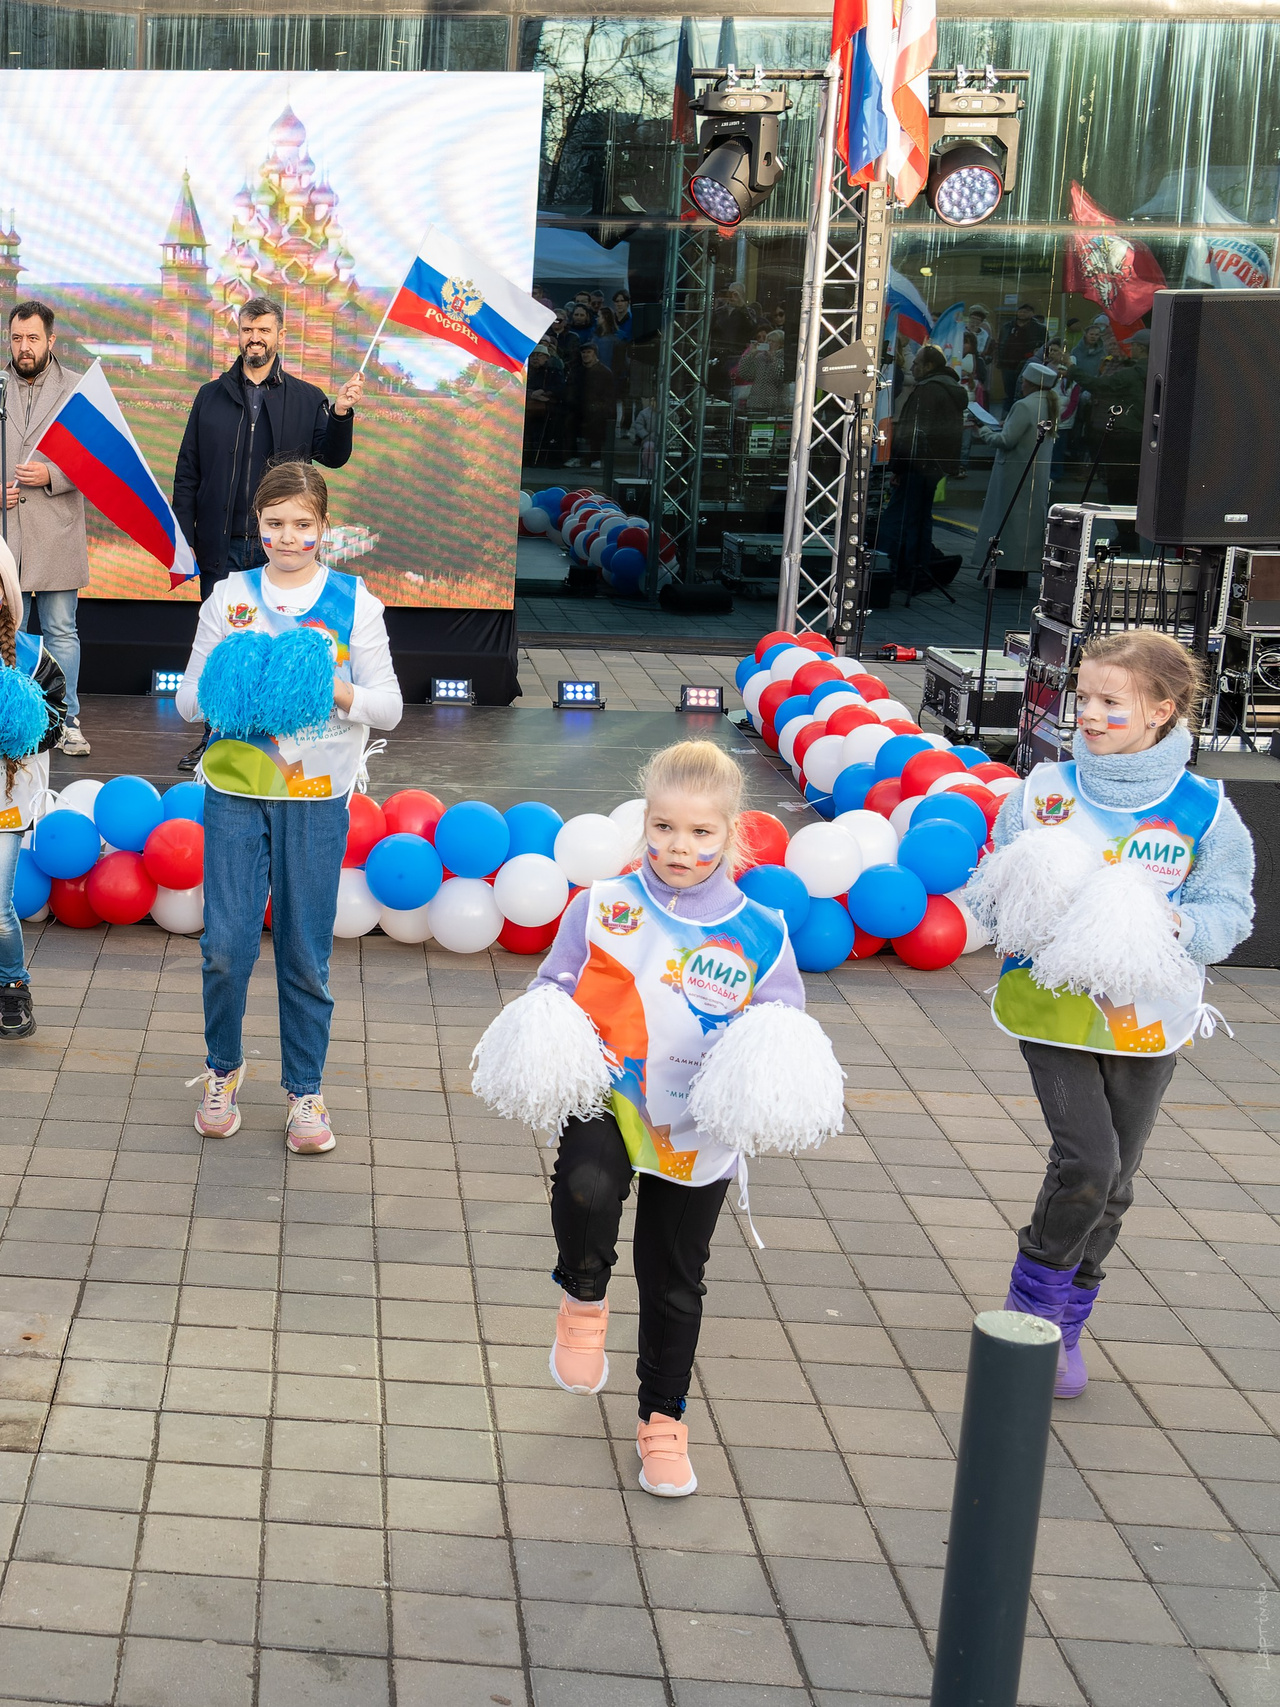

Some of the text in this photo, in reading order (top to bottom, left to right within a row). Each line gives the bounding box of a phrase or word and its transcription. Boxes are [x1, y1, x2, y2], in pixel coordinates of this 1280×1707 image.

[424, 307, 478, 345] РОССИЯ
[1128, 840, 1186, 864] МИР
[1144, 864, 1182, 876] ЛОДЫХ
[690, 954, 747, 988] МИР
[687, 976, 739, 1002] МОЛОДЫХ
